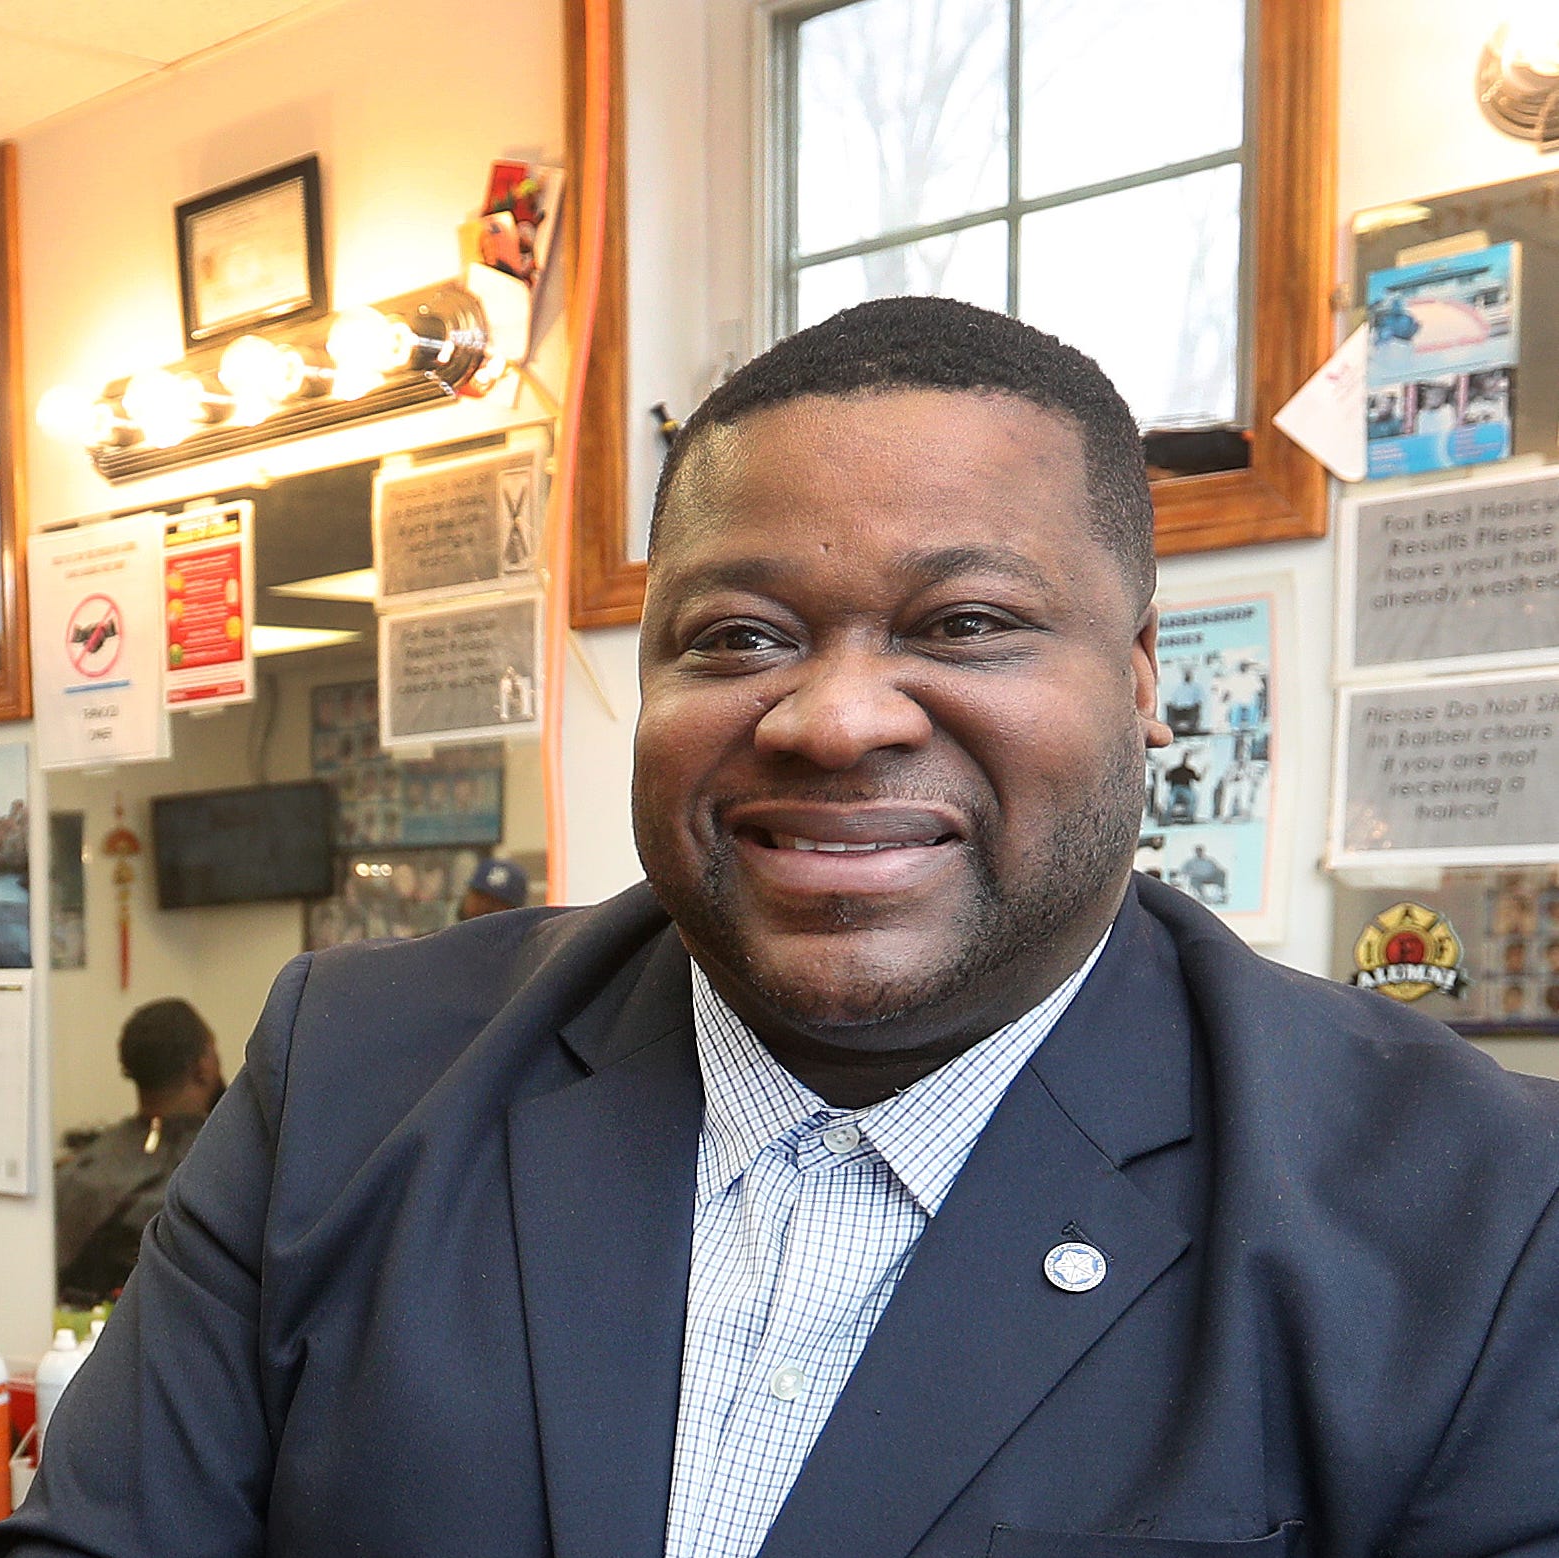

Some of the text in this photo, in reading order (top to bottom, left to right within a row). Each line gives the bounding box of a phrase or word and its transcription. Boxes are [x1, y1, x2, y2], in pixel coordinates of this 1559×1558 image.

[1423, 506, 1473, 528] Best
[1476, 525, 1555, 546] Please
[1454, 555, 1504, 579] your
[1366, 705, 1438, 723] Please
[1445, 700, 1479, 719] Do
[1485, 696, 1530, 716] Not
[1398, 727, 1472, 748] Barber
[1401, 757, 1445, 776] you
[1450, 753, 1492, 771] are
[1498, 748, 1538, 767] not
[1508, 775, 1527, 793] a
[1355, 963, 1458, 995] ALUMNI
